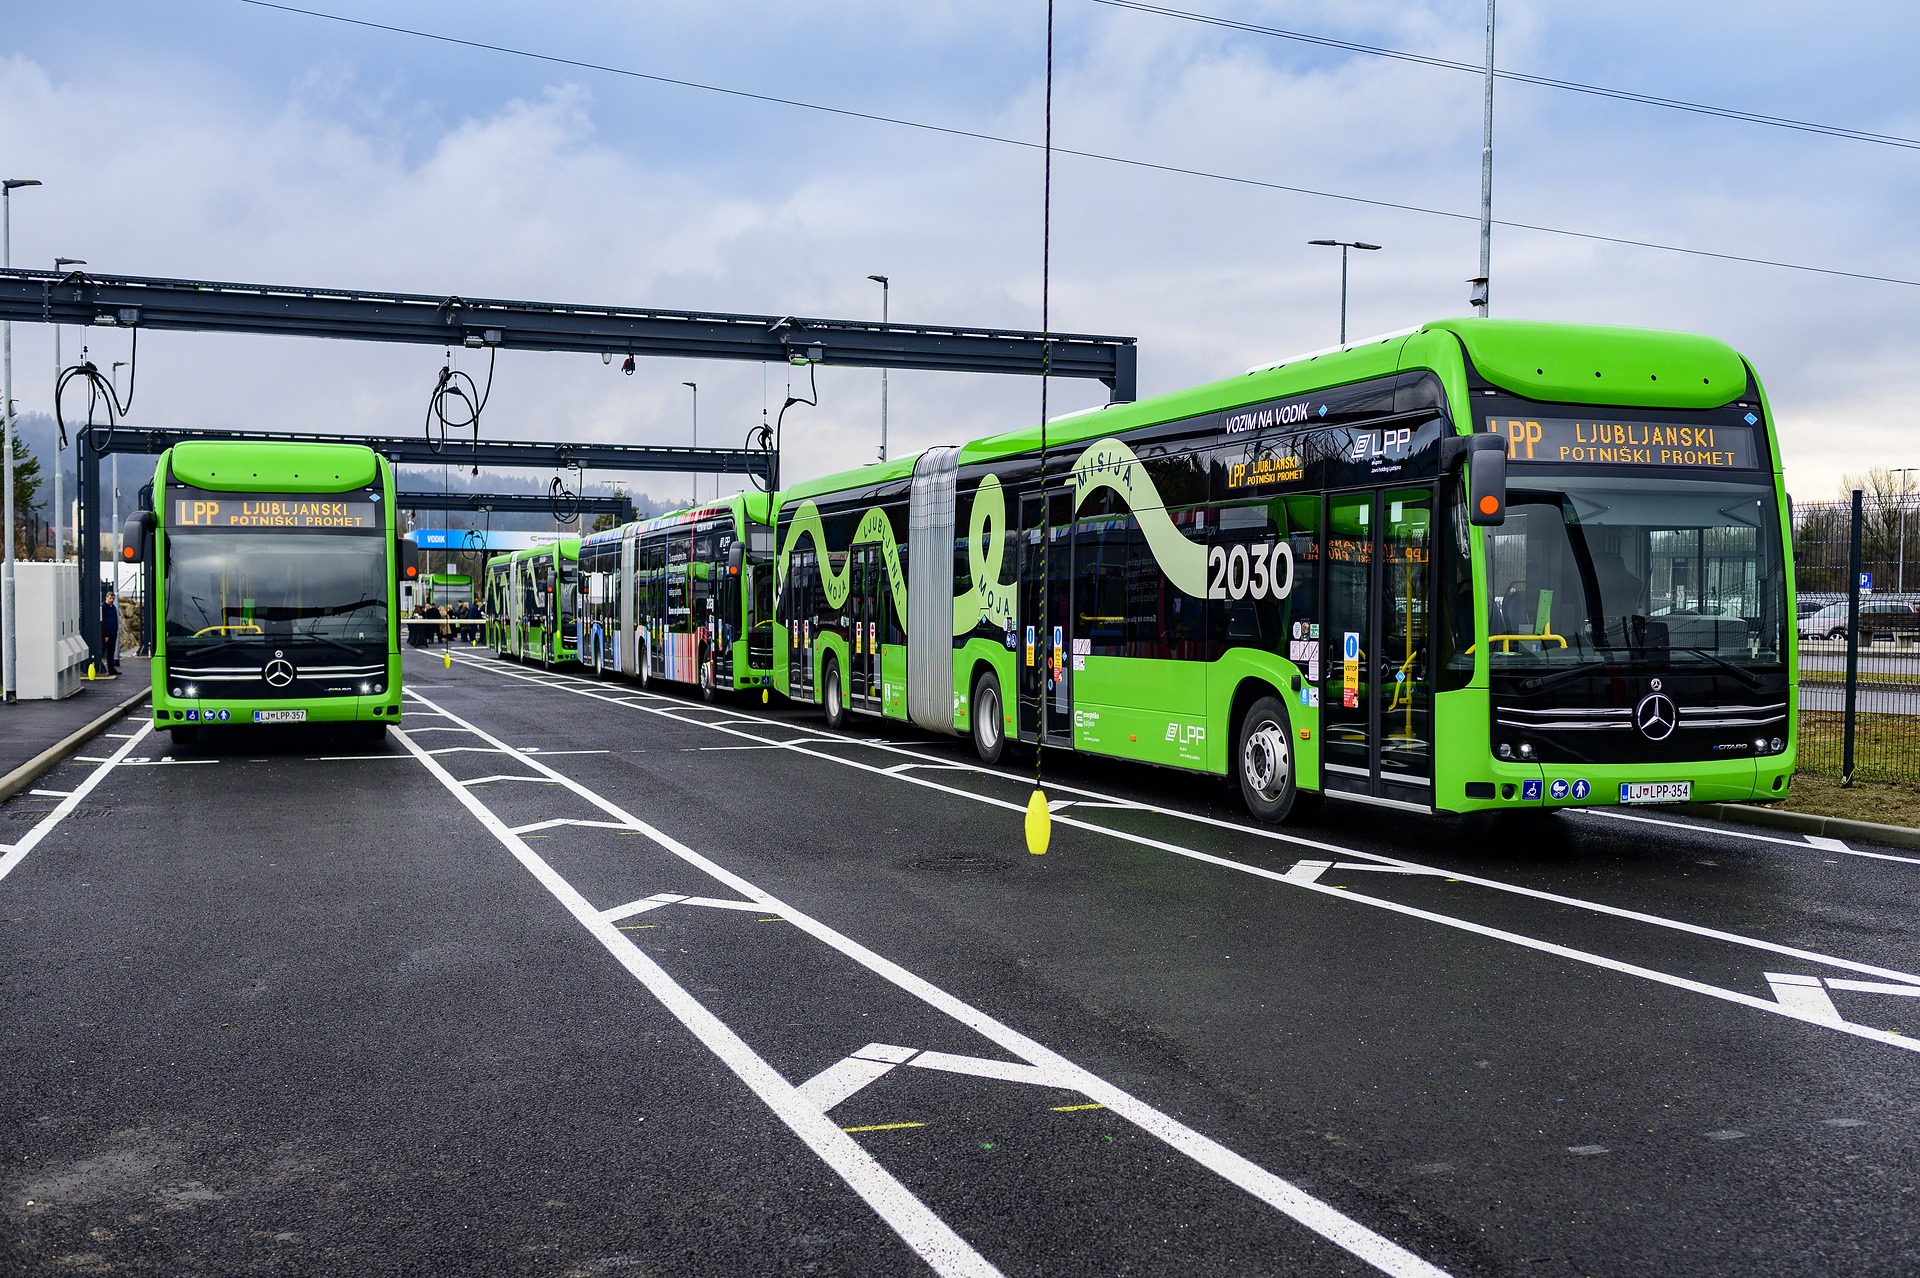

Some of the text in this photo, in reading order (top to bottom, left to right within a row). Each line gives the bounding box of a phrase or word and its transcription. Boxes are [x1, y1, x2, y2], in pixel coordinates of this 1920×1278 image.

[1226, 402, 1310, 434] VOZIM NA VODIK
[1371, 428, 1411, 456] LPP
[1576, 423, 1714, 448] LJUBLJANSKI
[1252, 456, 1297, 474] LJUBLJANSKI
[1560, 446, 1735, 466] POTNIŠKI PROMET
[1077, 451, 1133, 491] MISIJA.
[1229, 464, 1246, 488] LPP
[1247, 469, 1304, 486] POTNIŠKI PROMET
[181, 501, 220, 525] LPP
[243, 502, 347, 516] LJUBLJANSKI
[230, 515, 362, 526] POTNIŠKI PROMET
[427, 535, 446, 543] VODIK
[1208, 542, 1294, 600] 2030
[827, 579, 847, 600] MOJA
[978, 574, 1010, 616] MOJA
[260, 711, 305, 720] LJ LPP-357
[1179, 724, 1205, 745] LPP
[1629, 785, 1642, 799] LJ
[1650, 784, 1689, 799] LPP-354
